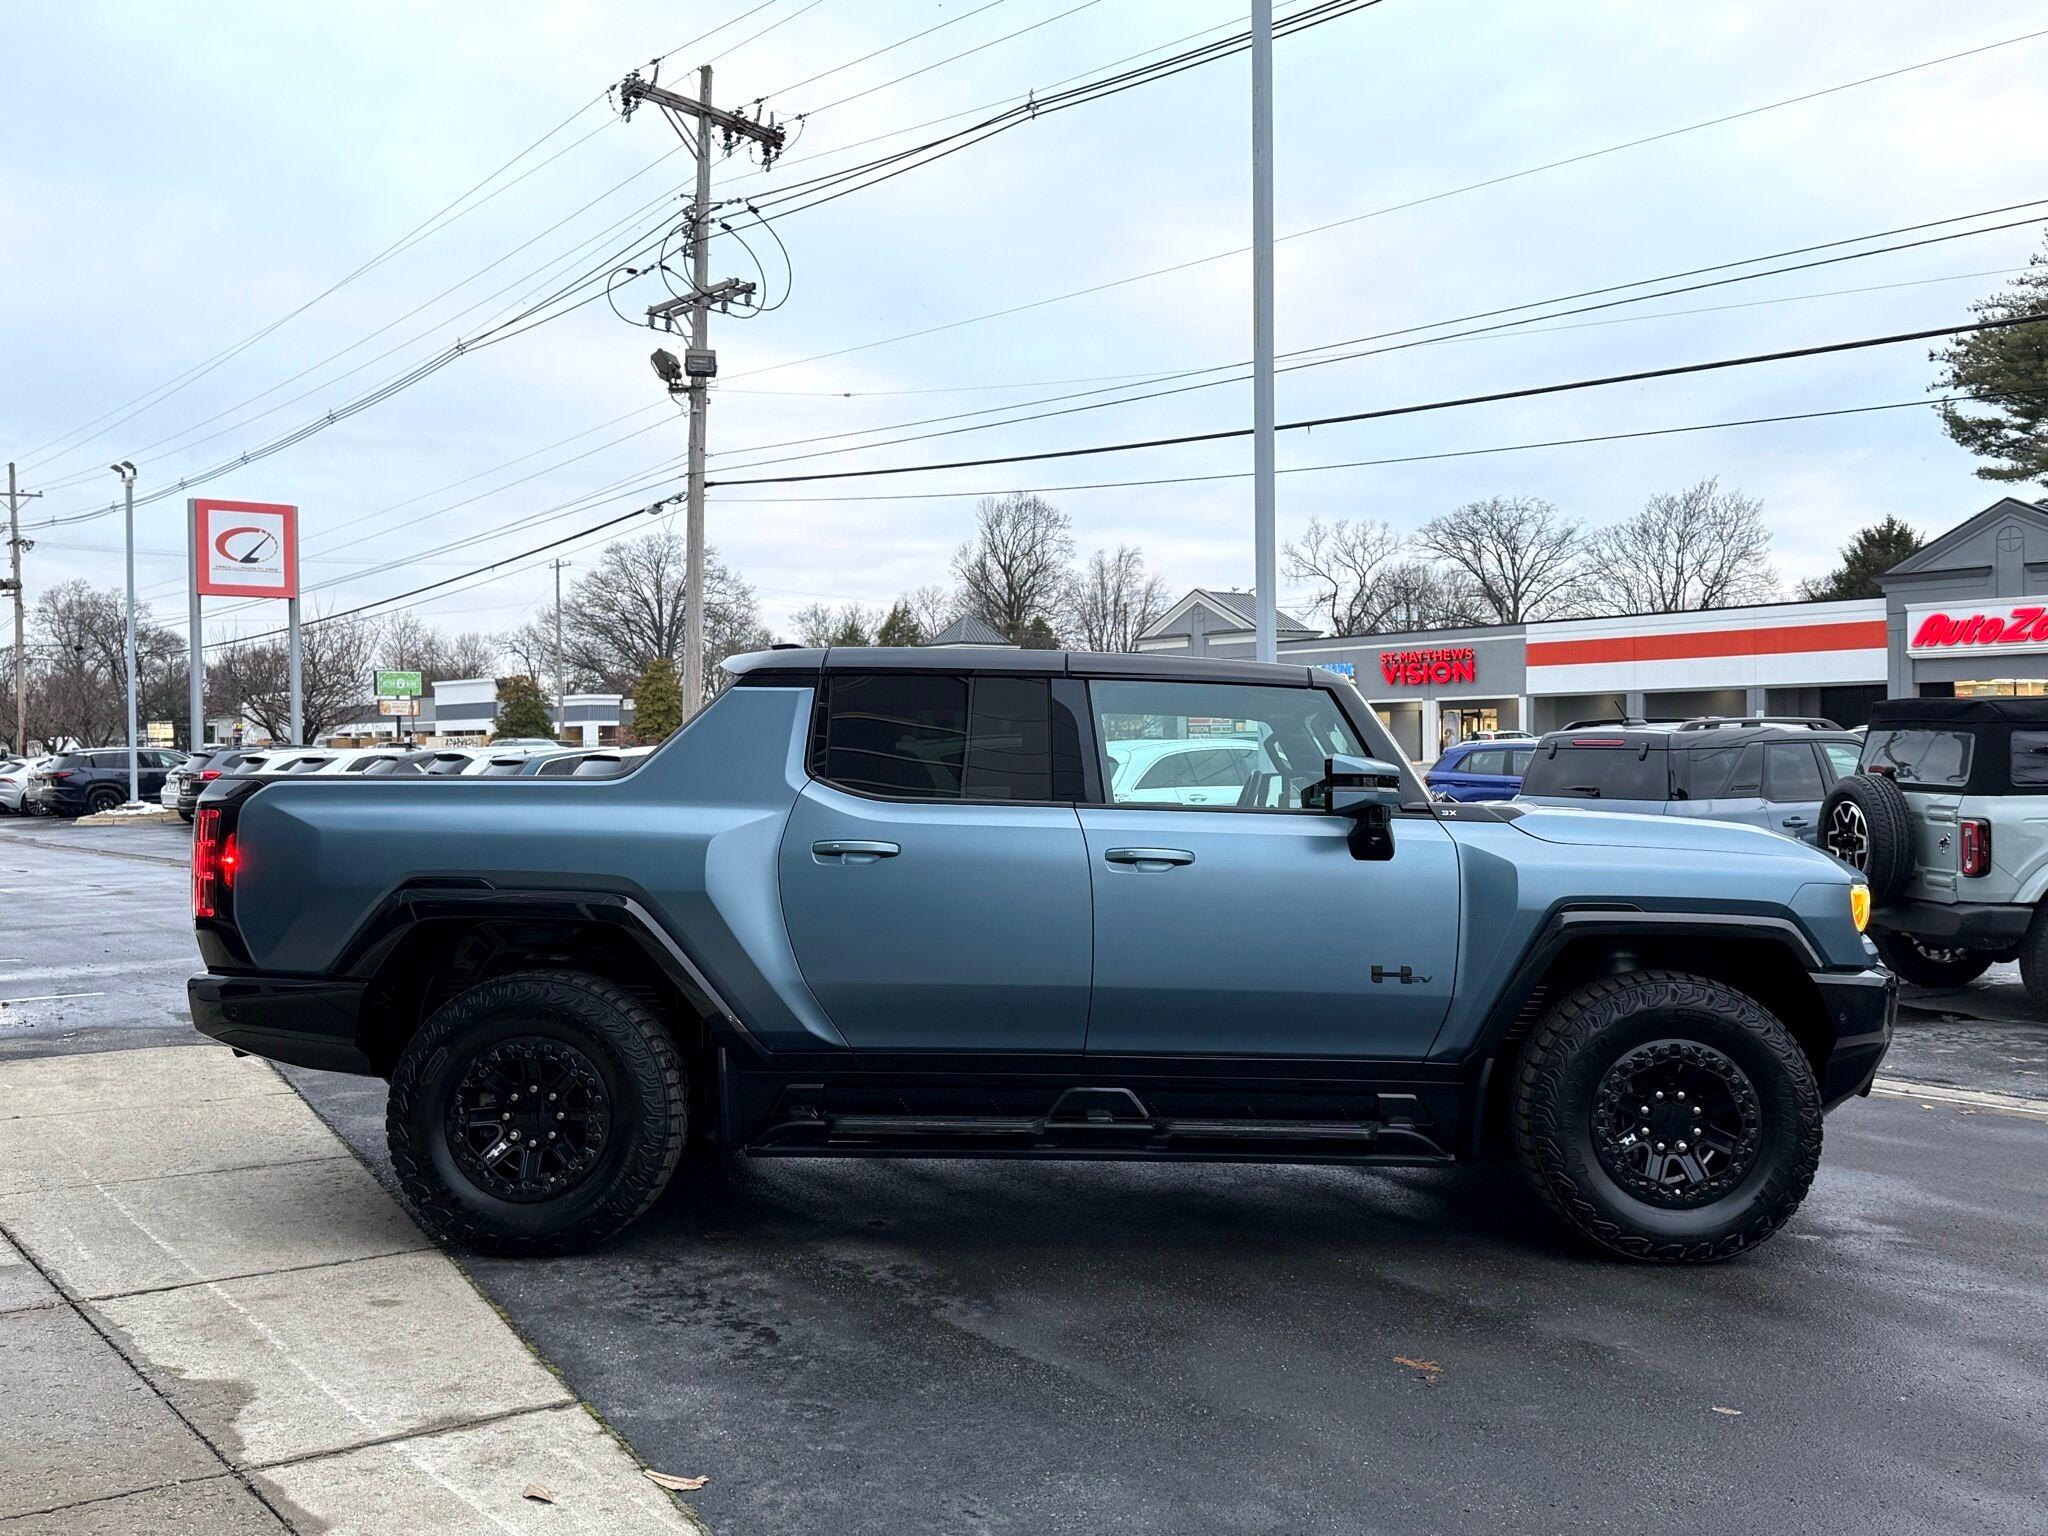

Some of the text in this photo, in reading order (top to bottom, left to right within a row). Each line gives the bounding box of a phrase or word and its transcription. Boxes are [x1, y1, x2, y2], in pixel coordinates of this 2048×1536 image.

[1380, 648, 1474, 664] ST. MATTHEWS
[1381, 660, 1475, 685] VISION
